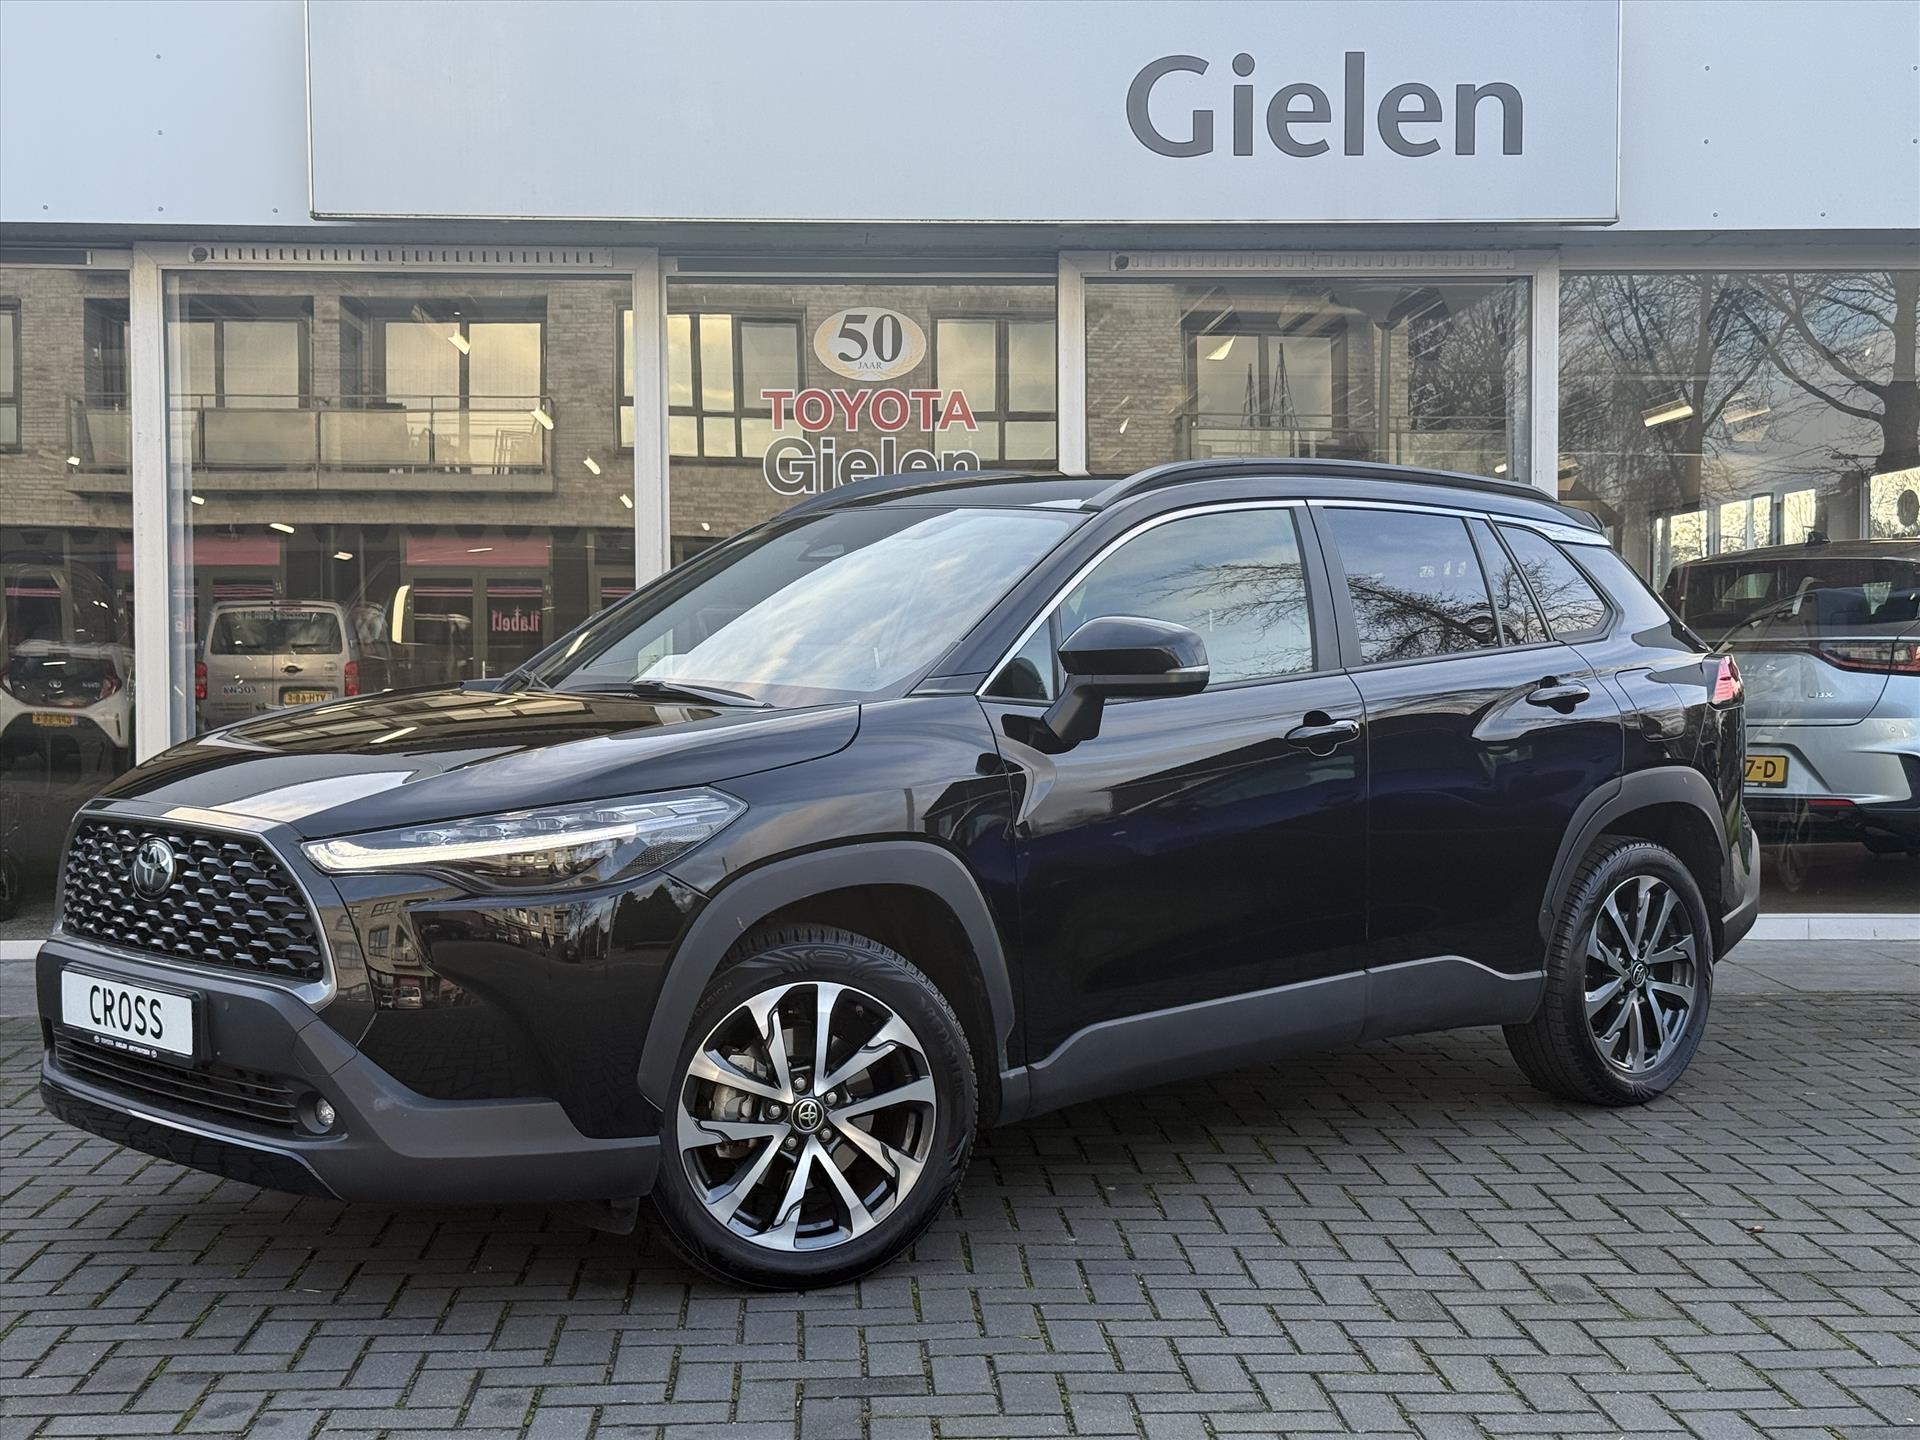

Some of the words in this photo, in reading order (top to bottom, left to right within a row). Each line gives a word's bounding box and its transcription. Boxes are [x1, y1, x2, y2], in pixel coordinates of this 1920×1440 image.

[1126, 51, 1523, 158] Gielen
[837, 313, 903, 363] 50
[857, 361, 882, 370] JAAR
[760, 388, 979, 432] TOYOTA
[89, 984, 164, 1040] CROSS
